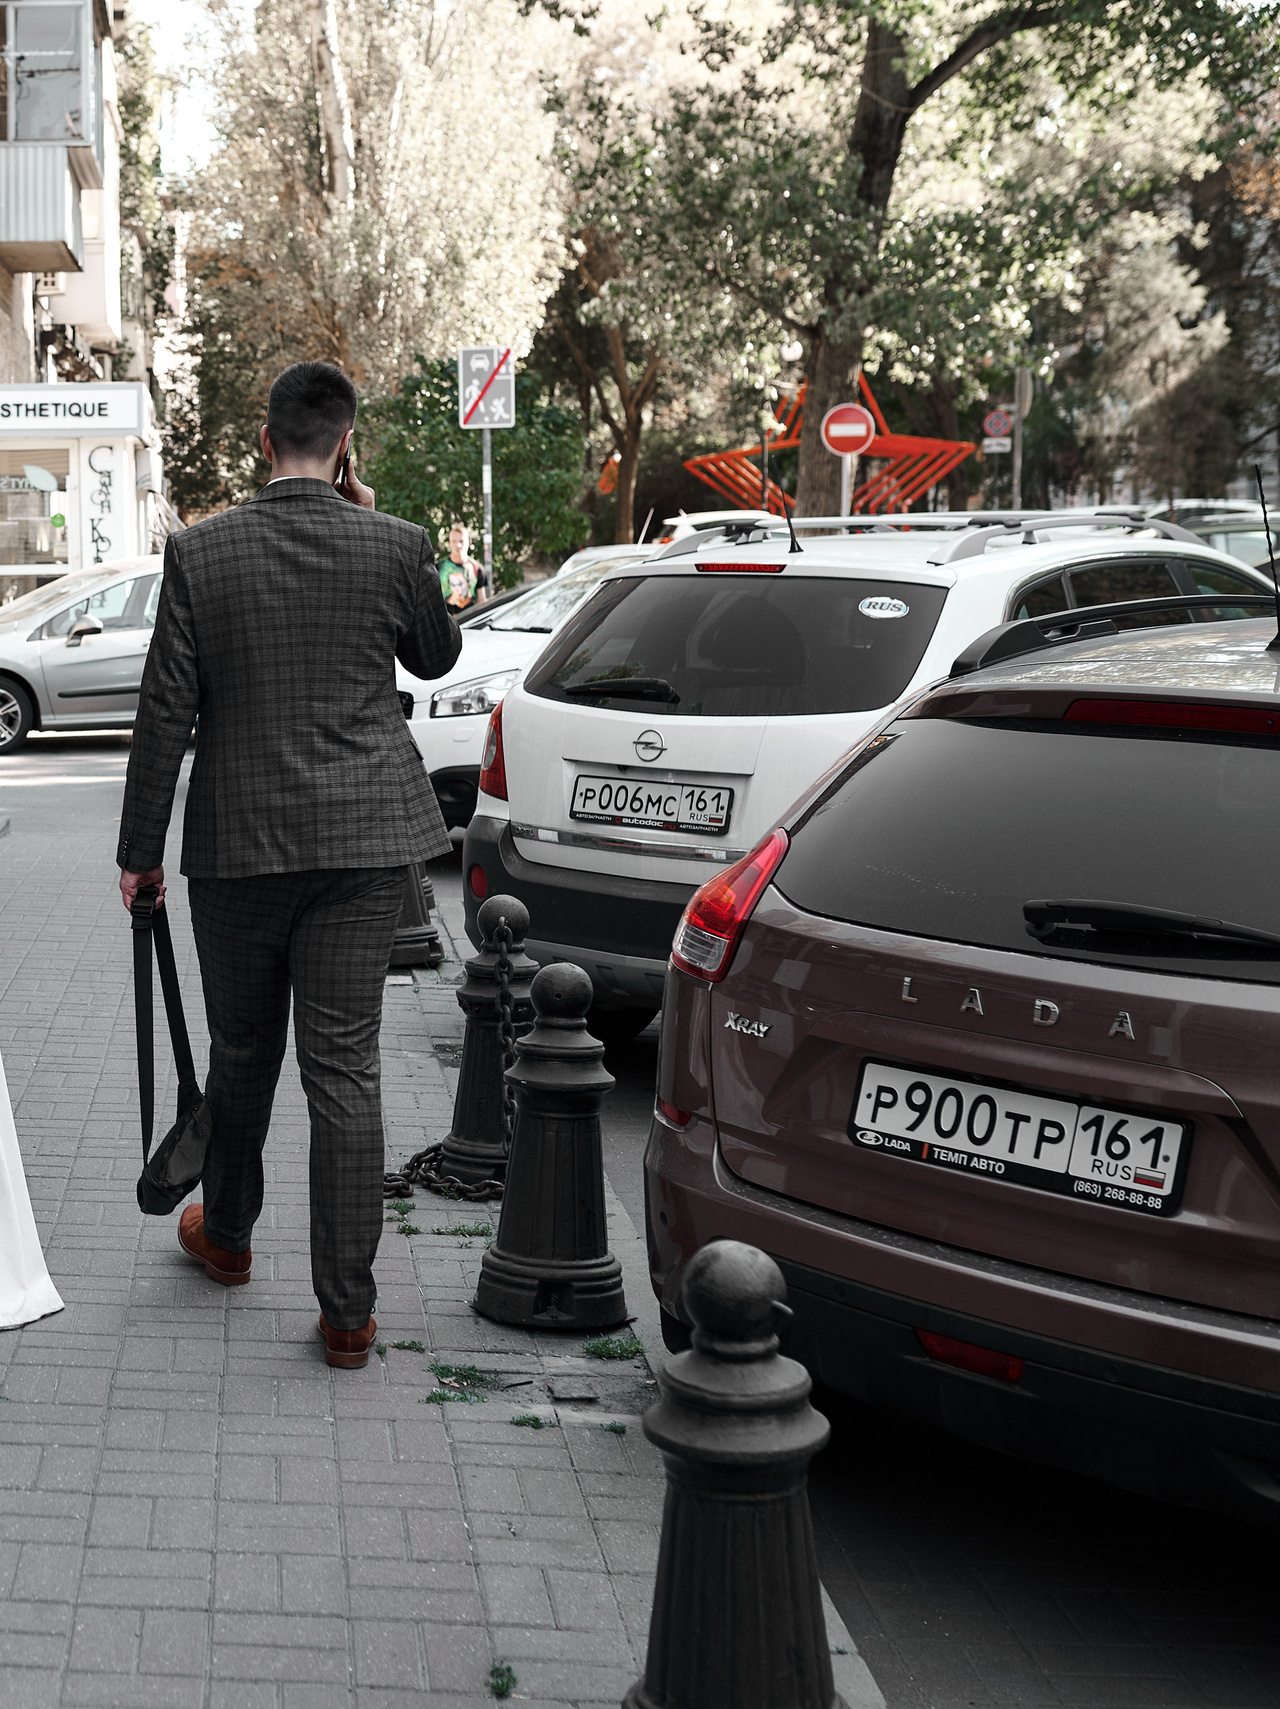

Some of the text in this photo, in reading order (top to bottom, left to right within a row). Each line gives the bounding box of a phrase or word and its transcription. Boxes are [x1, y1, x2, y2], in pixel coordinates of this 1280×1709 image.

[865, 601, 903, 612] RUS
[685, 789, 722, 813] 161
[689, 812, 709, 822] RUS
[900, 976, 1136, 1041] LADA
[884, 1137, 912, 1152] LADA
[1081, 1115, 1166, 1169] 161
[933, 1147, 1006, 1175] ТЕМП АВТО
[1091, 1159, 1132, 1181] RUS
[1073, 1180, 1163, 1210] (863) 268-88-88
